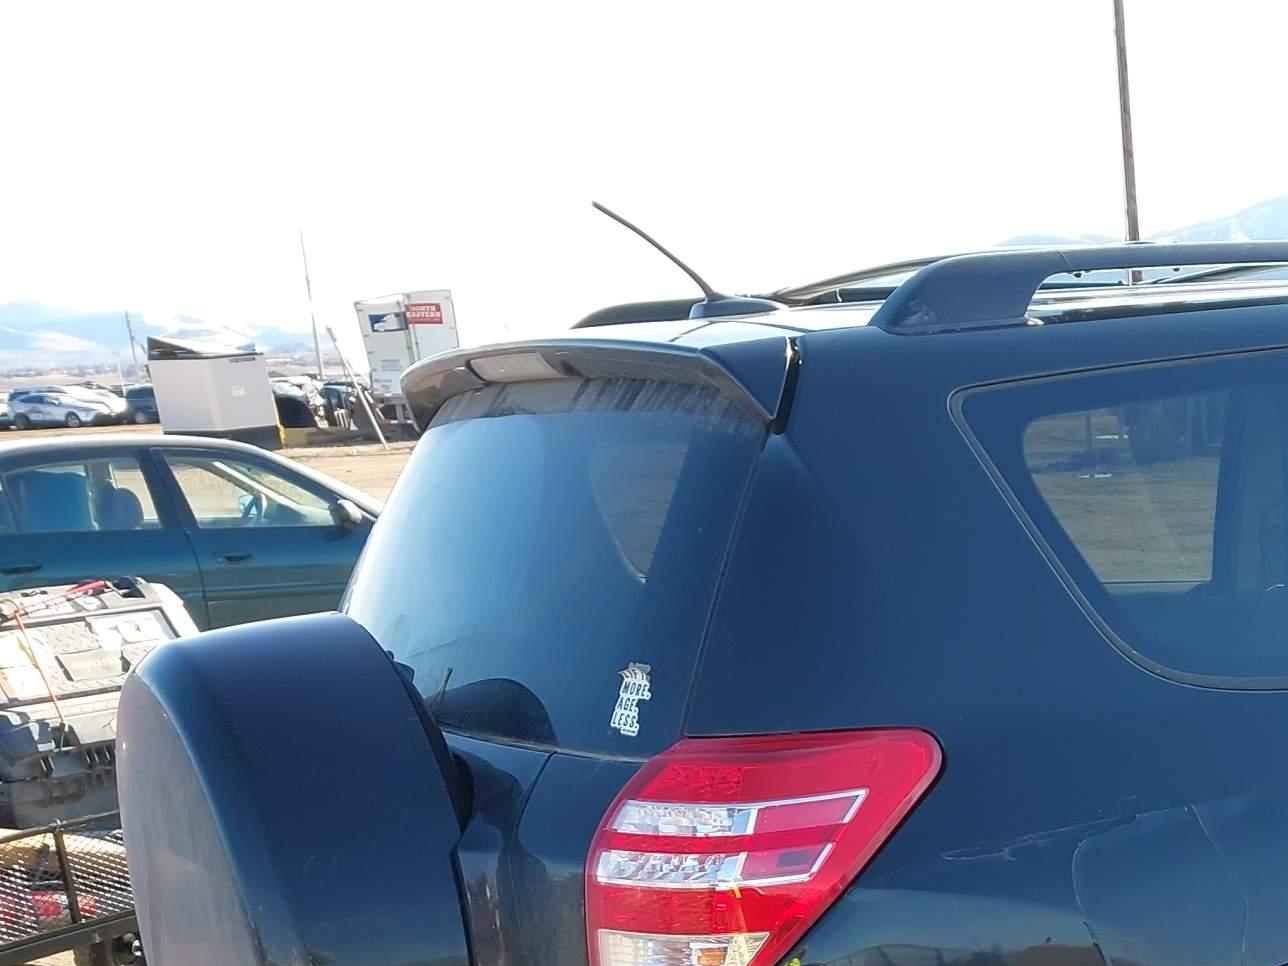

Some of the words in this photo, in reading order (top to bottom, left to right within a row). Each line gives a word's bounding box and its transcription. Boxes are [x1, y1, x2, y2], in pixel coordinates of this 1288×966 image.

[621, 681, 650, 698] MORE.
[617, 696, 638, 713] AGE.
[612, 711, 638, 729] LESS.
